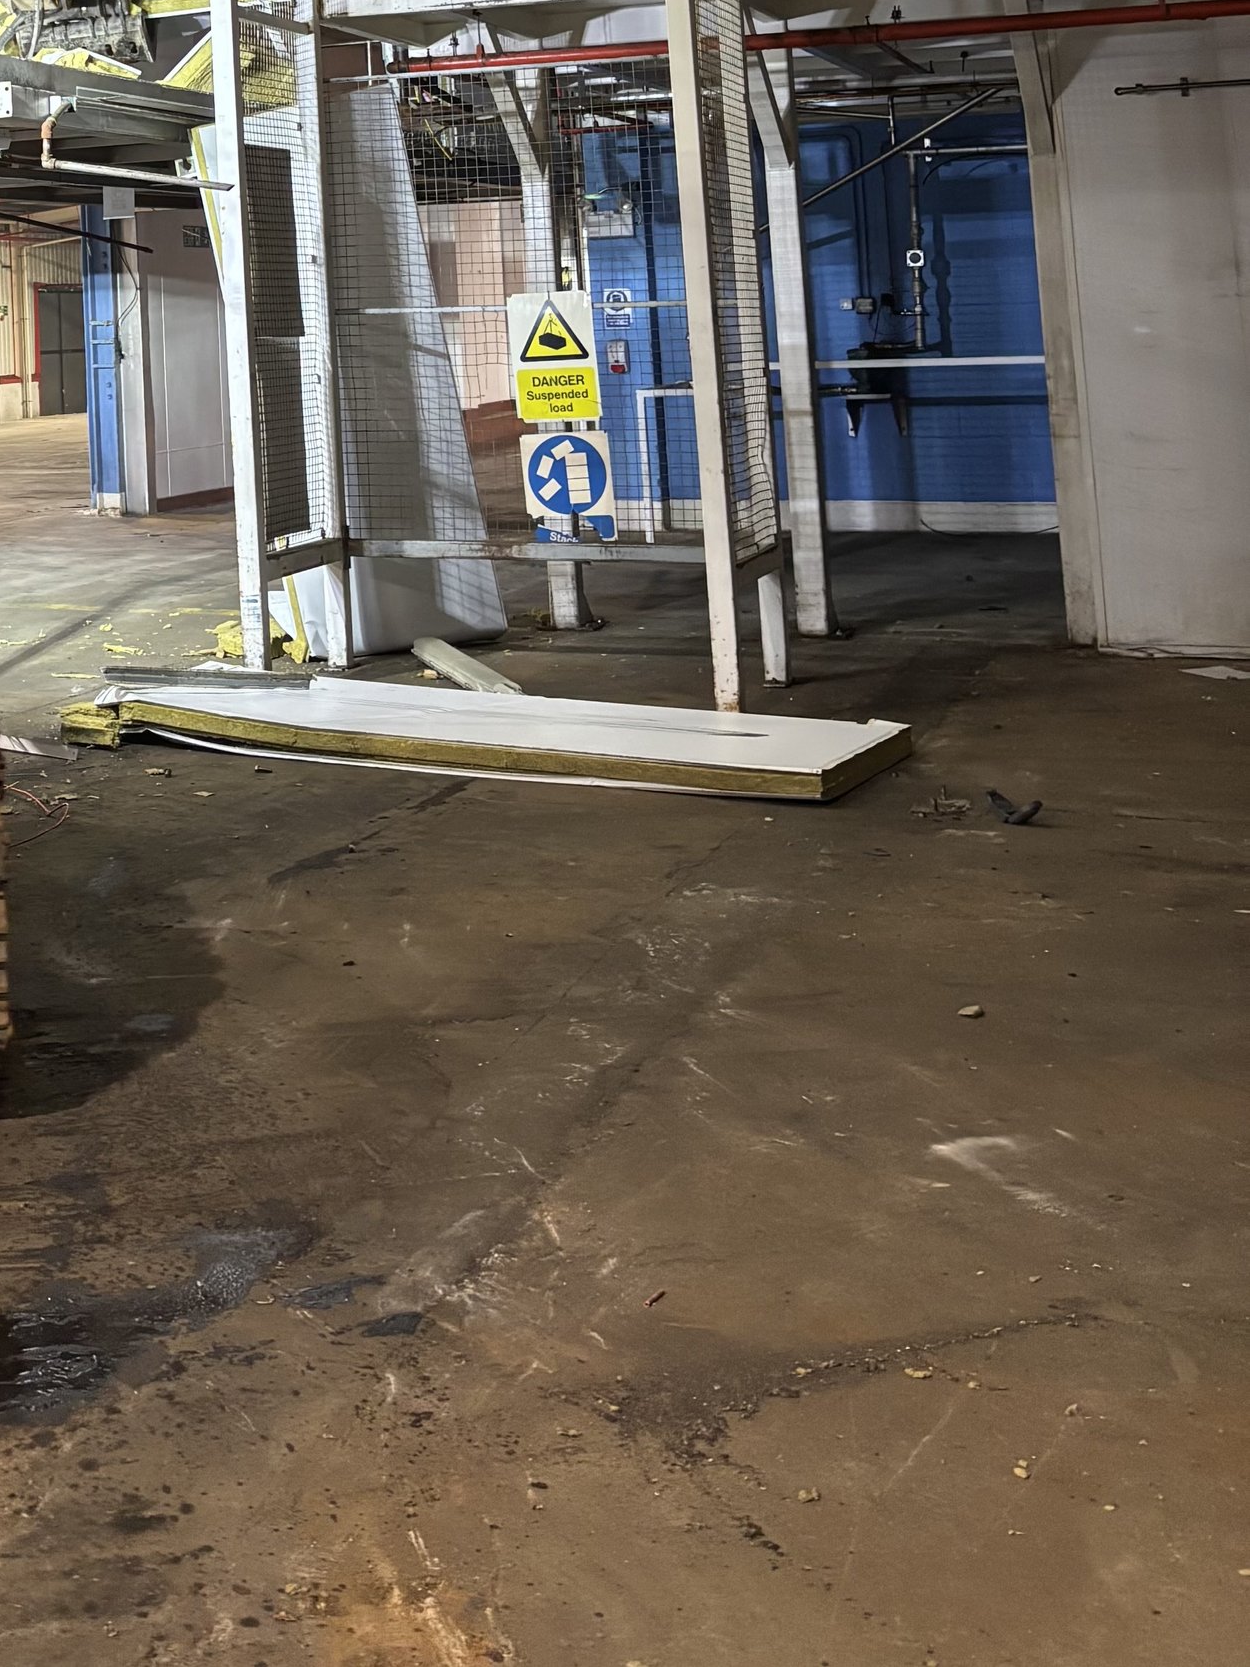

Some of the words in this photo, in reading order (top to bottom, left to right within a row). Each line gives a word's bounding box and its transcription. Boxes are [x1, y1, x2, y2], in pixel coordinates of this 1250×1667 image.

[532, 374, 585, 387] DANGER
[526, 388, 589, 402] Suspended
[549, 402, 574, 413] load
